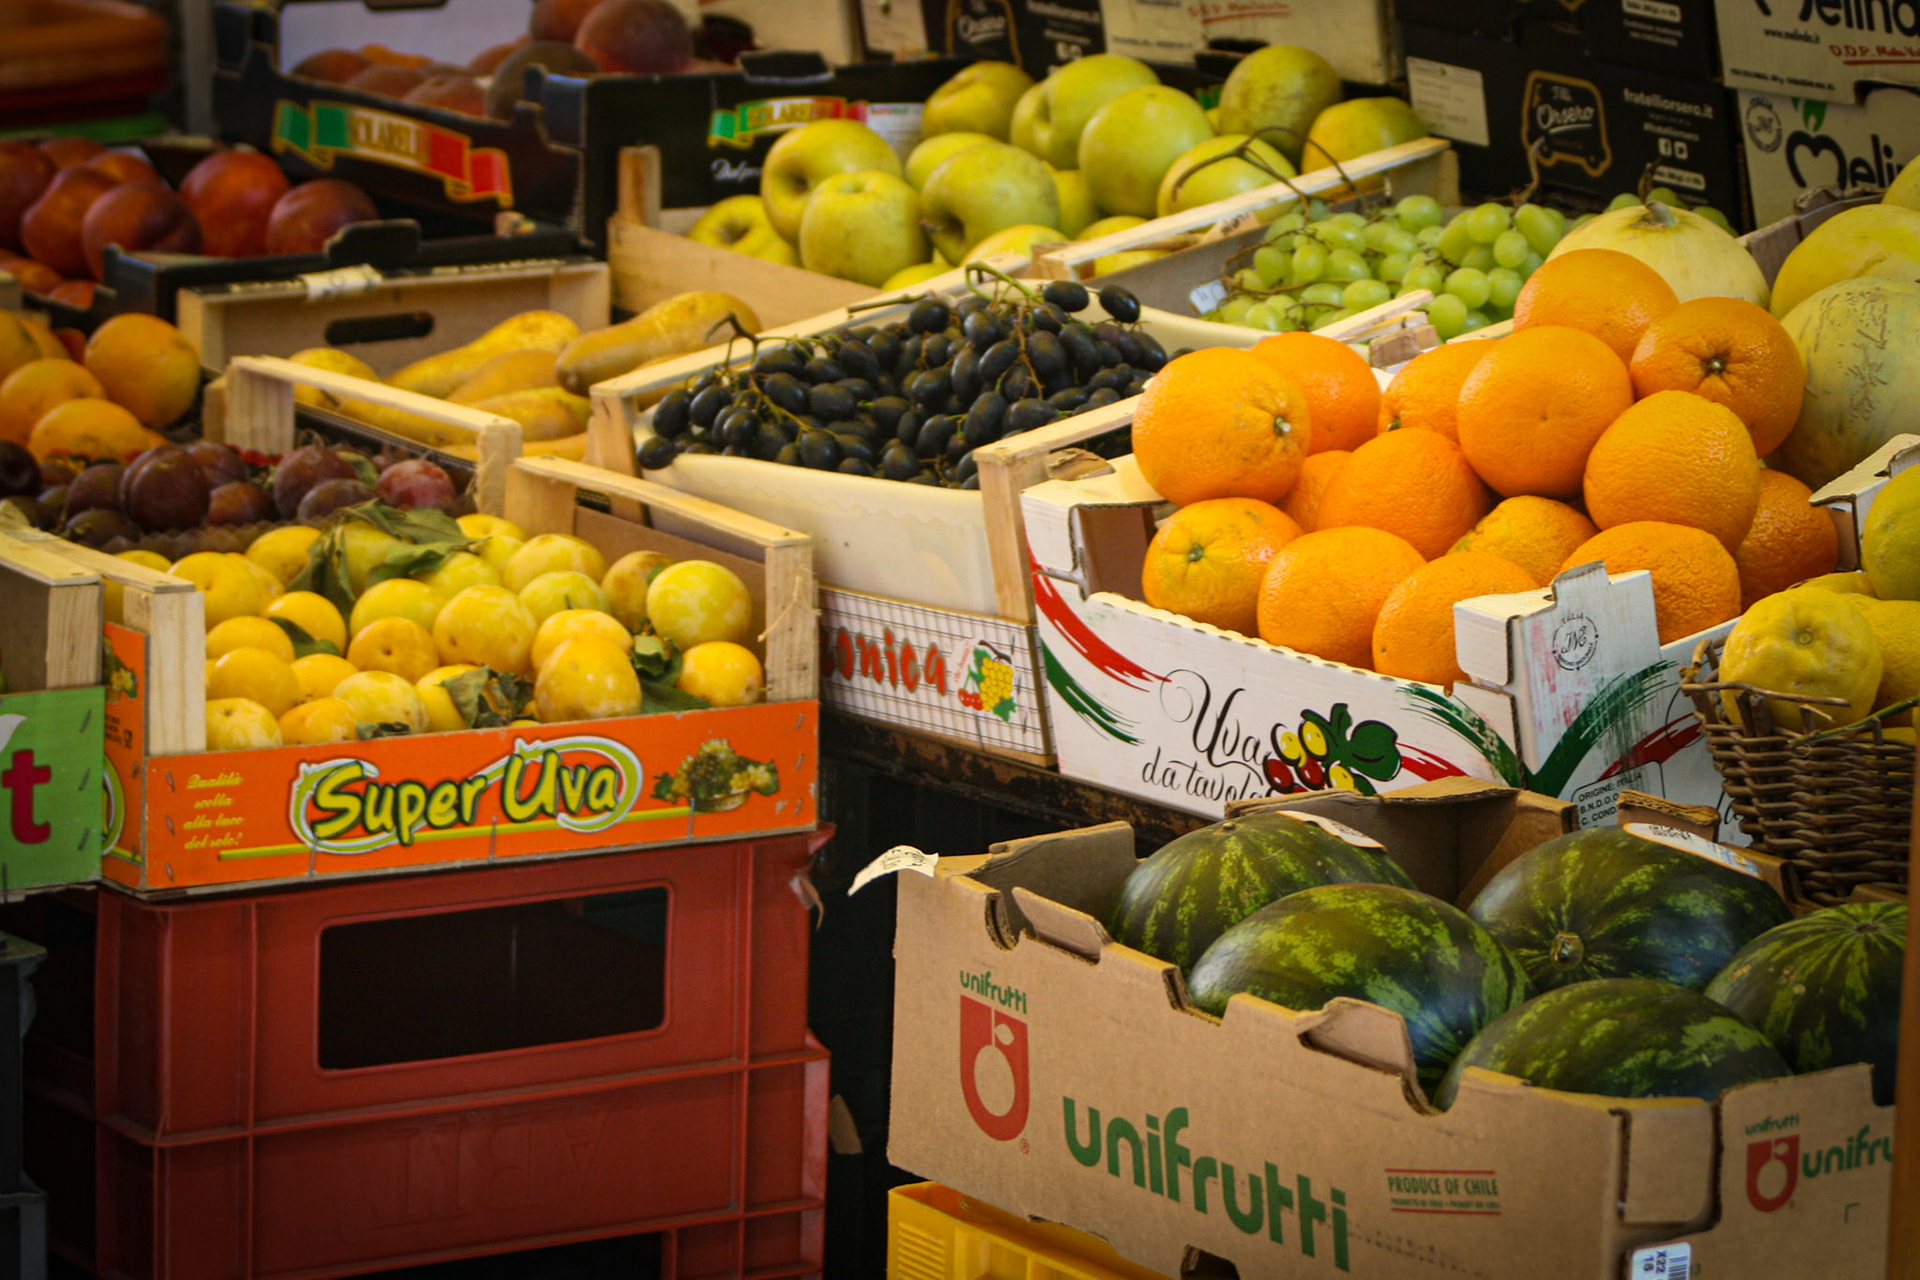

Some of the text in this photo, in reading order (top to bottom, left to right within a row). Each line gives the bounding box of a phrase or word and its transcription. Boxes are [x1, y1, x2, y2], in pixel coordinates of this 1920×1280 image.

[1160, 669, 1273, 770] Uva
[1142, 746, 1181, 791] da
[1578, 772, 1643, 802] ORIGINE: ITALIA
[312, 749, 620, 846] Super Uva
[1592, 803, 1618, 821] COND.
[960, 970, 1027, 1015] unifrutti
[1745, 1113, 1800, 1136] unifrutti
[1063, 1096, 1349, 1273] unifrutti
[1388, 1176, 1499, 1196] PRODUCE OF CHILE
[1656, 1250, 1667, 1273] X22
